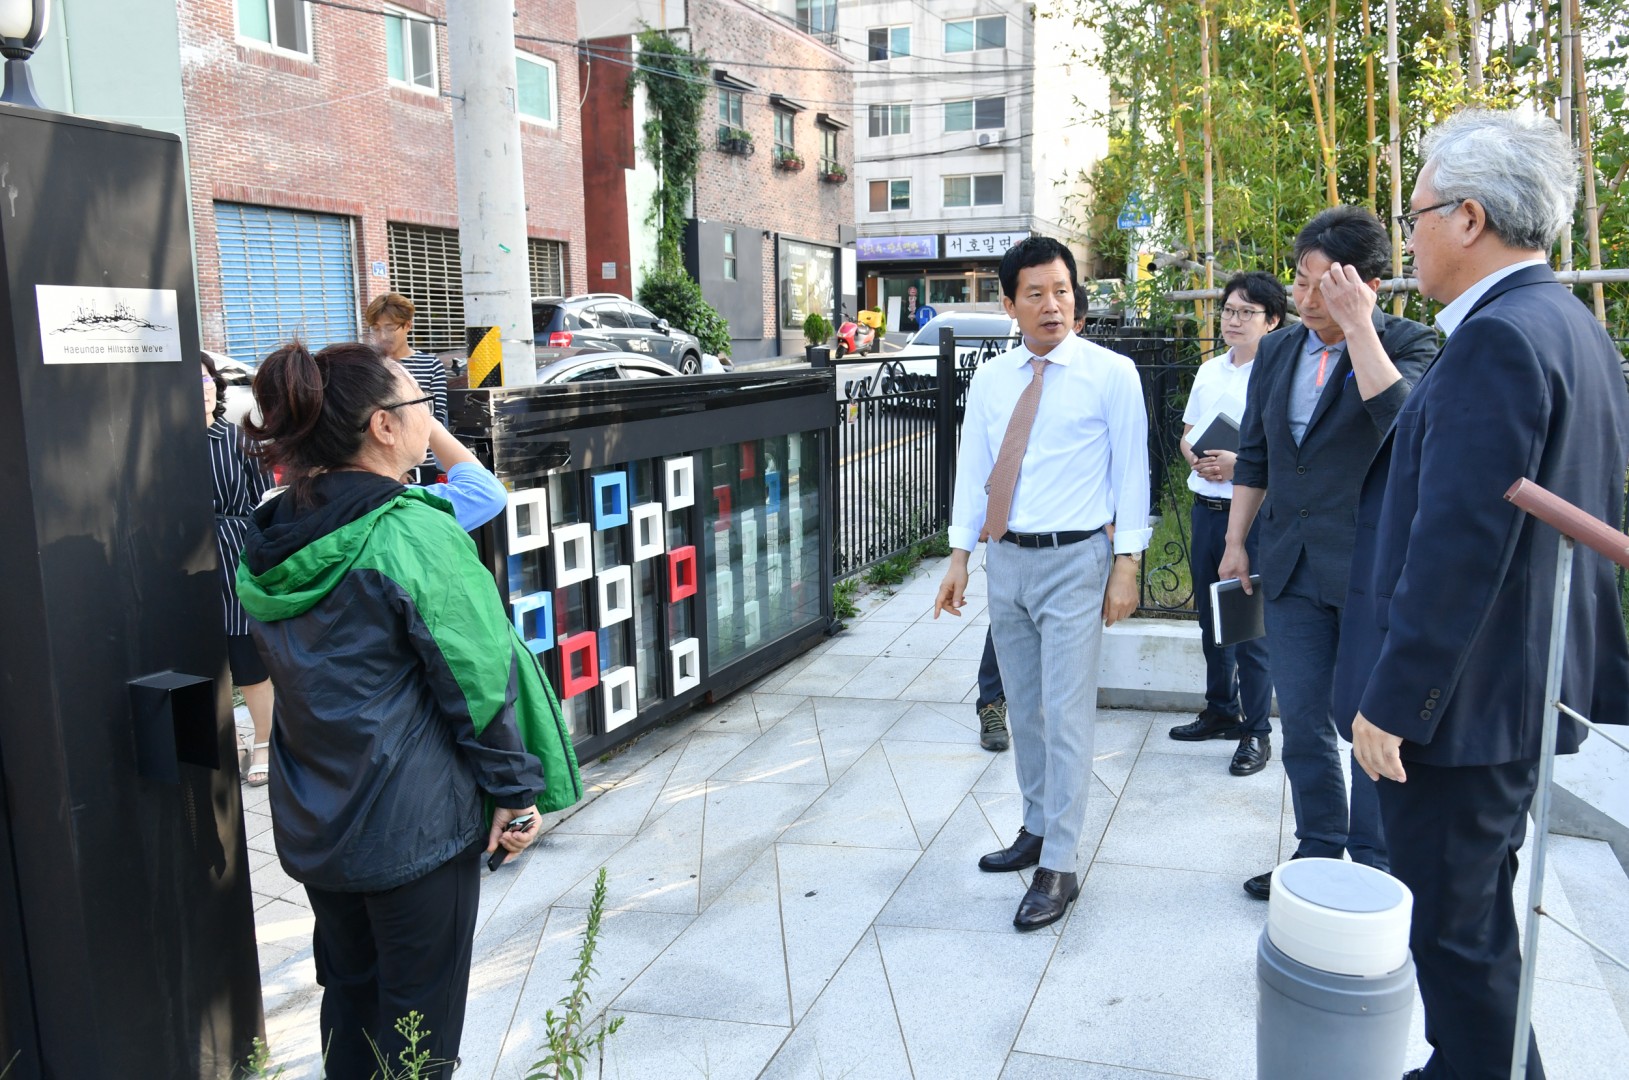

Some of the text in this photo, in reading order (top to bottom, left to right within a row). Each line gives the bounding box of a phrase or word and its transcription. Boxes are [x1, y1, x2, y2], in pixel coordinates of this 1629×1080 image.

[949, 235, 1011, 254] 서호밀면
[63, 344, 164, 354] Haeundae Hillstate We've
